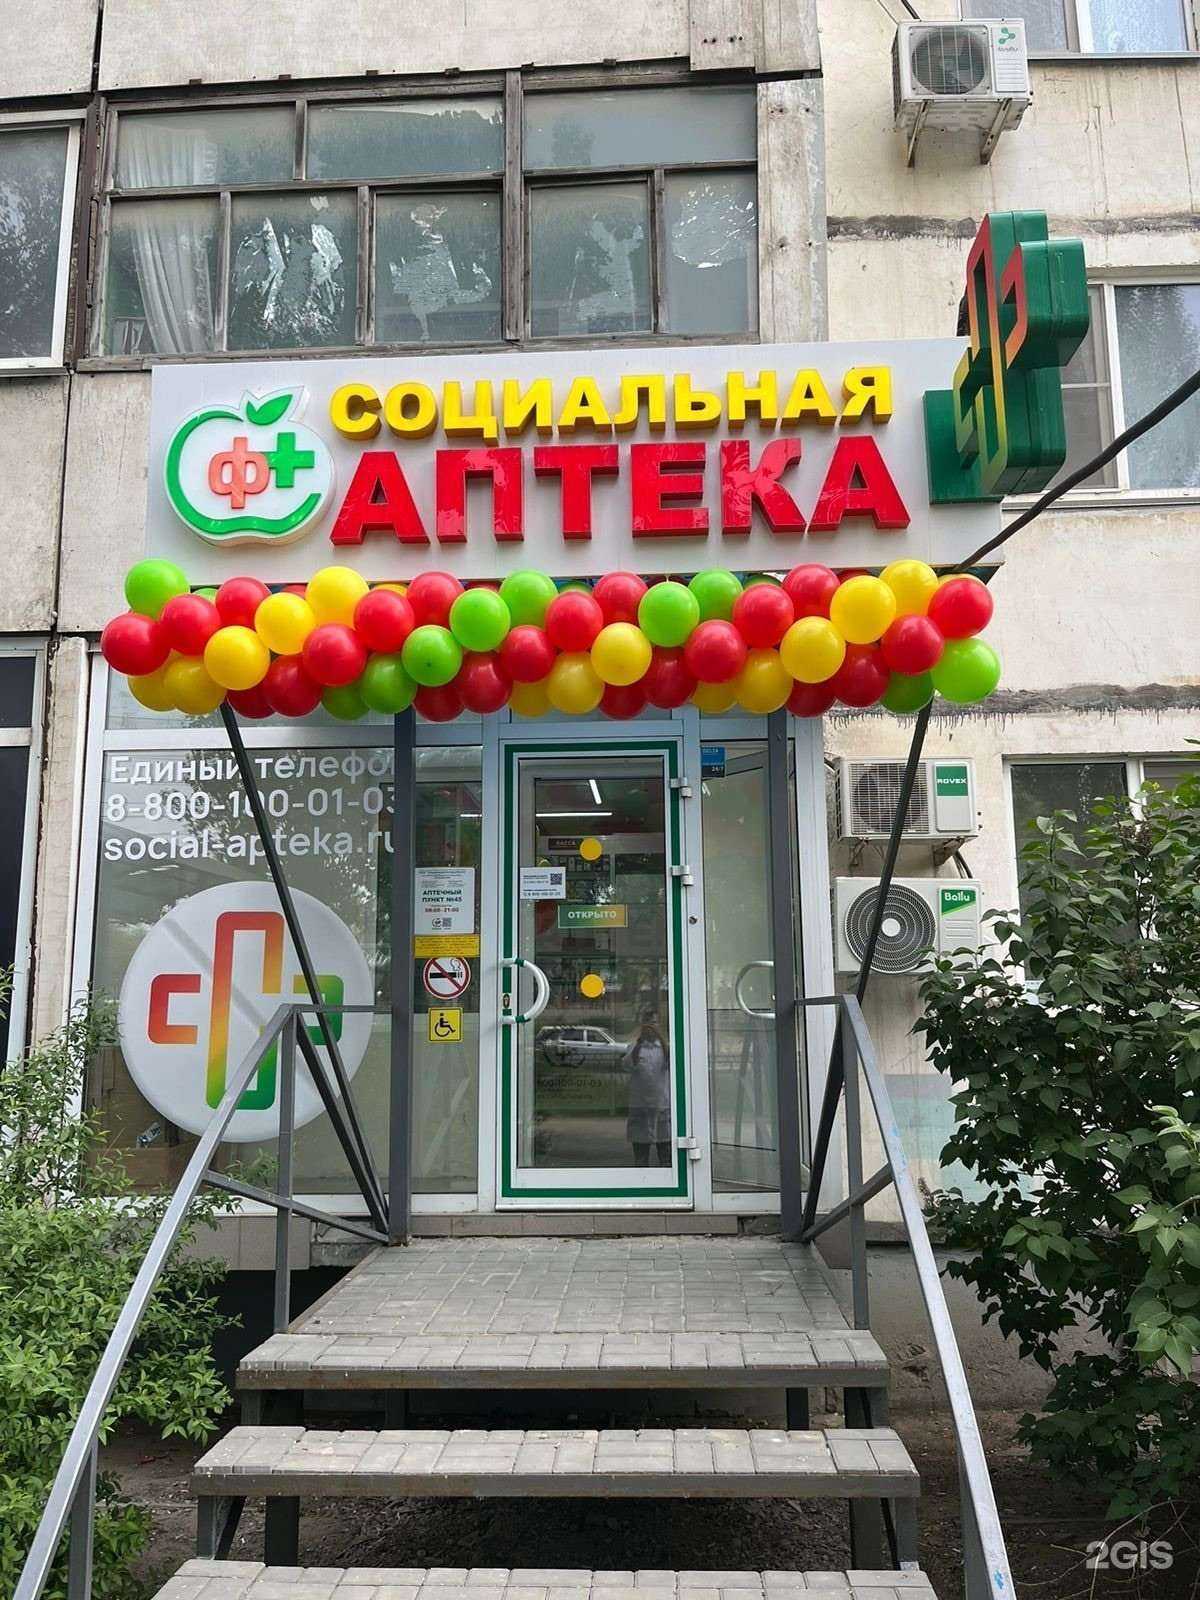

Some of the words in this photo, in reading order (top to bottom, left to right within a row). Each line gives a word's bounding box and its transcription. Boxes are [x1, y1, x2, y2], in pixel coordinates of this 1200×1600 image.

[330, 366, 894, 445] СОЦИАЛЬНАЯ
[330, 435, 911, 545] АПТЕКА
[567, 911, 617, 919] ОТКРЫТО
[944, 891, 970, 902] Ballu
